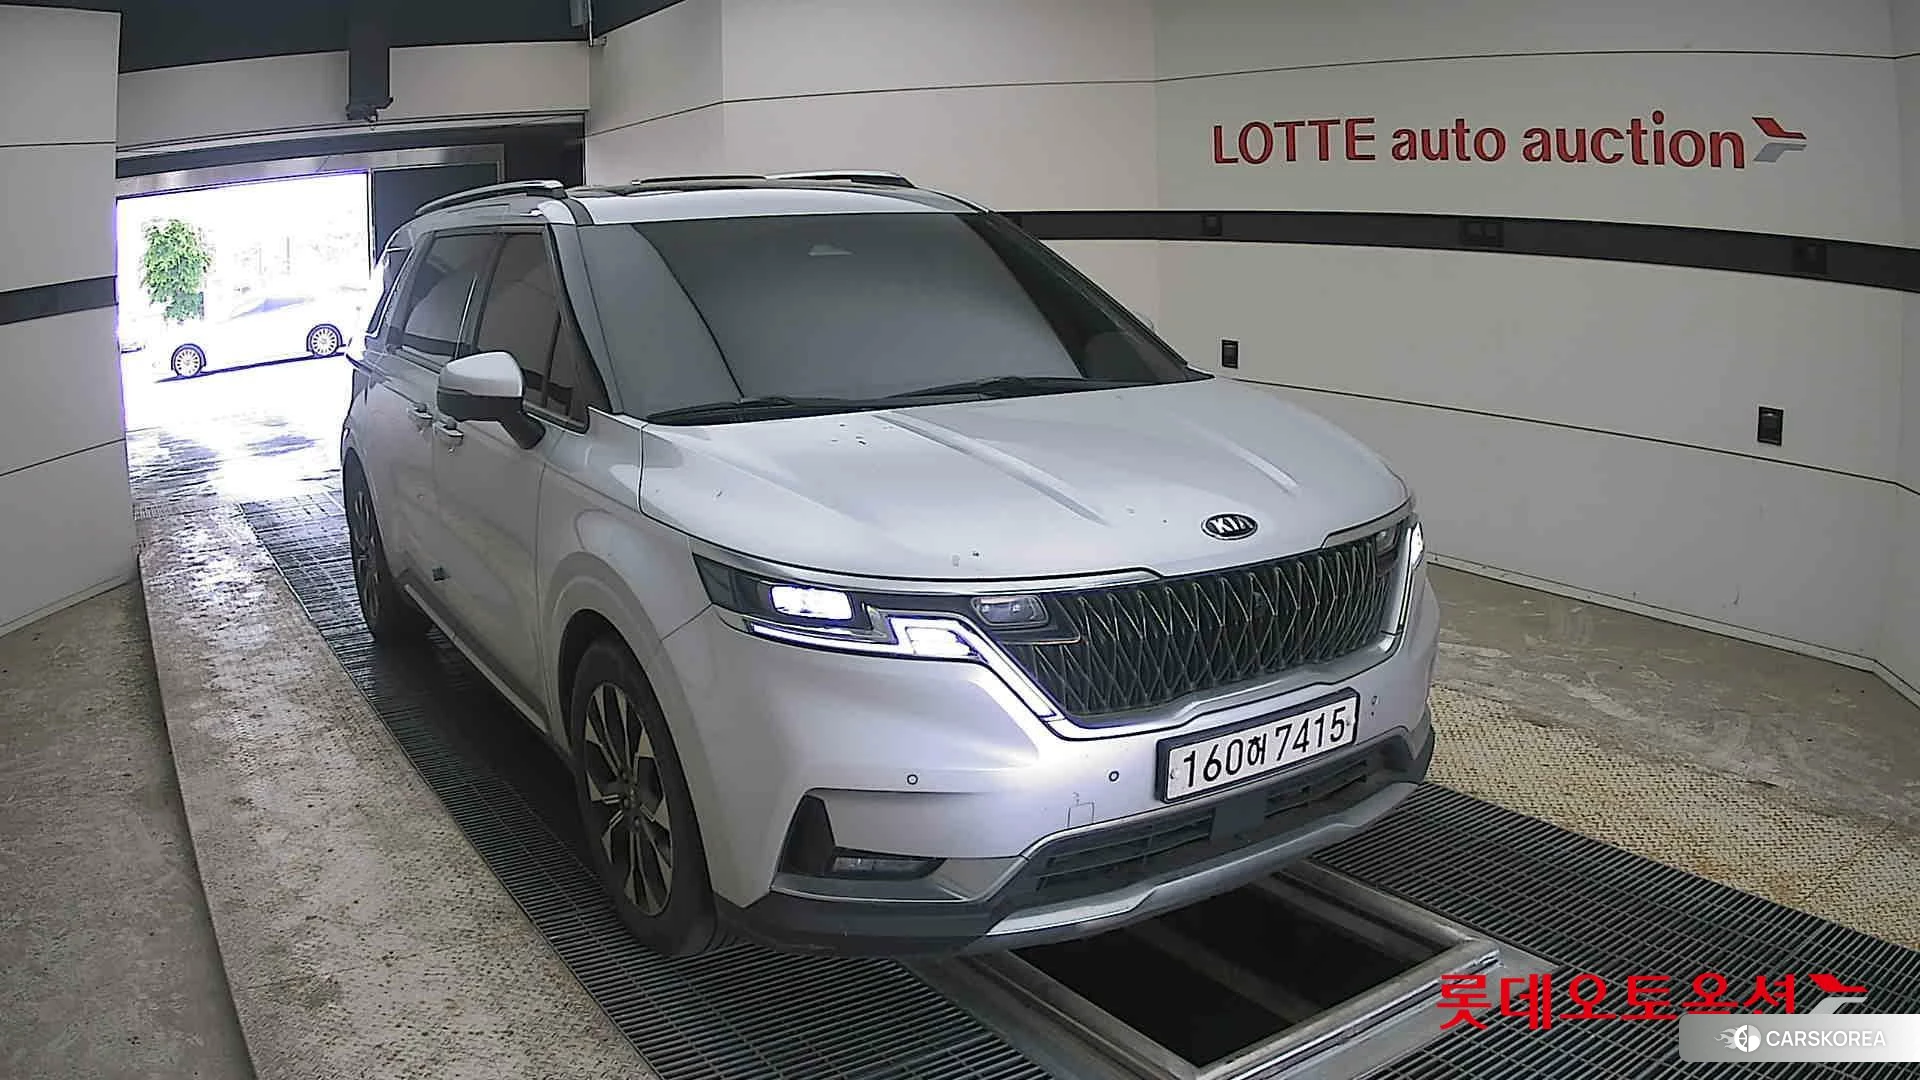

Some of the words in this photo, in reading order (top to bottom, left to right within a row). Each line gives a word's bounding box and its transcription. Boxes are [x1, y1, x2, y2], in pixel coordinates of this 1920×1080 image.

[1213, 117, 1376, 165] LOTTE
[1391, 118, 1506, 162] auto
[1522, 110, 1745, 169] auction
[1209, 515, 1254, 534] KIA
[1183, 732, 1267, 788] 160허
[1275, 706, 1346, 761] 7415
